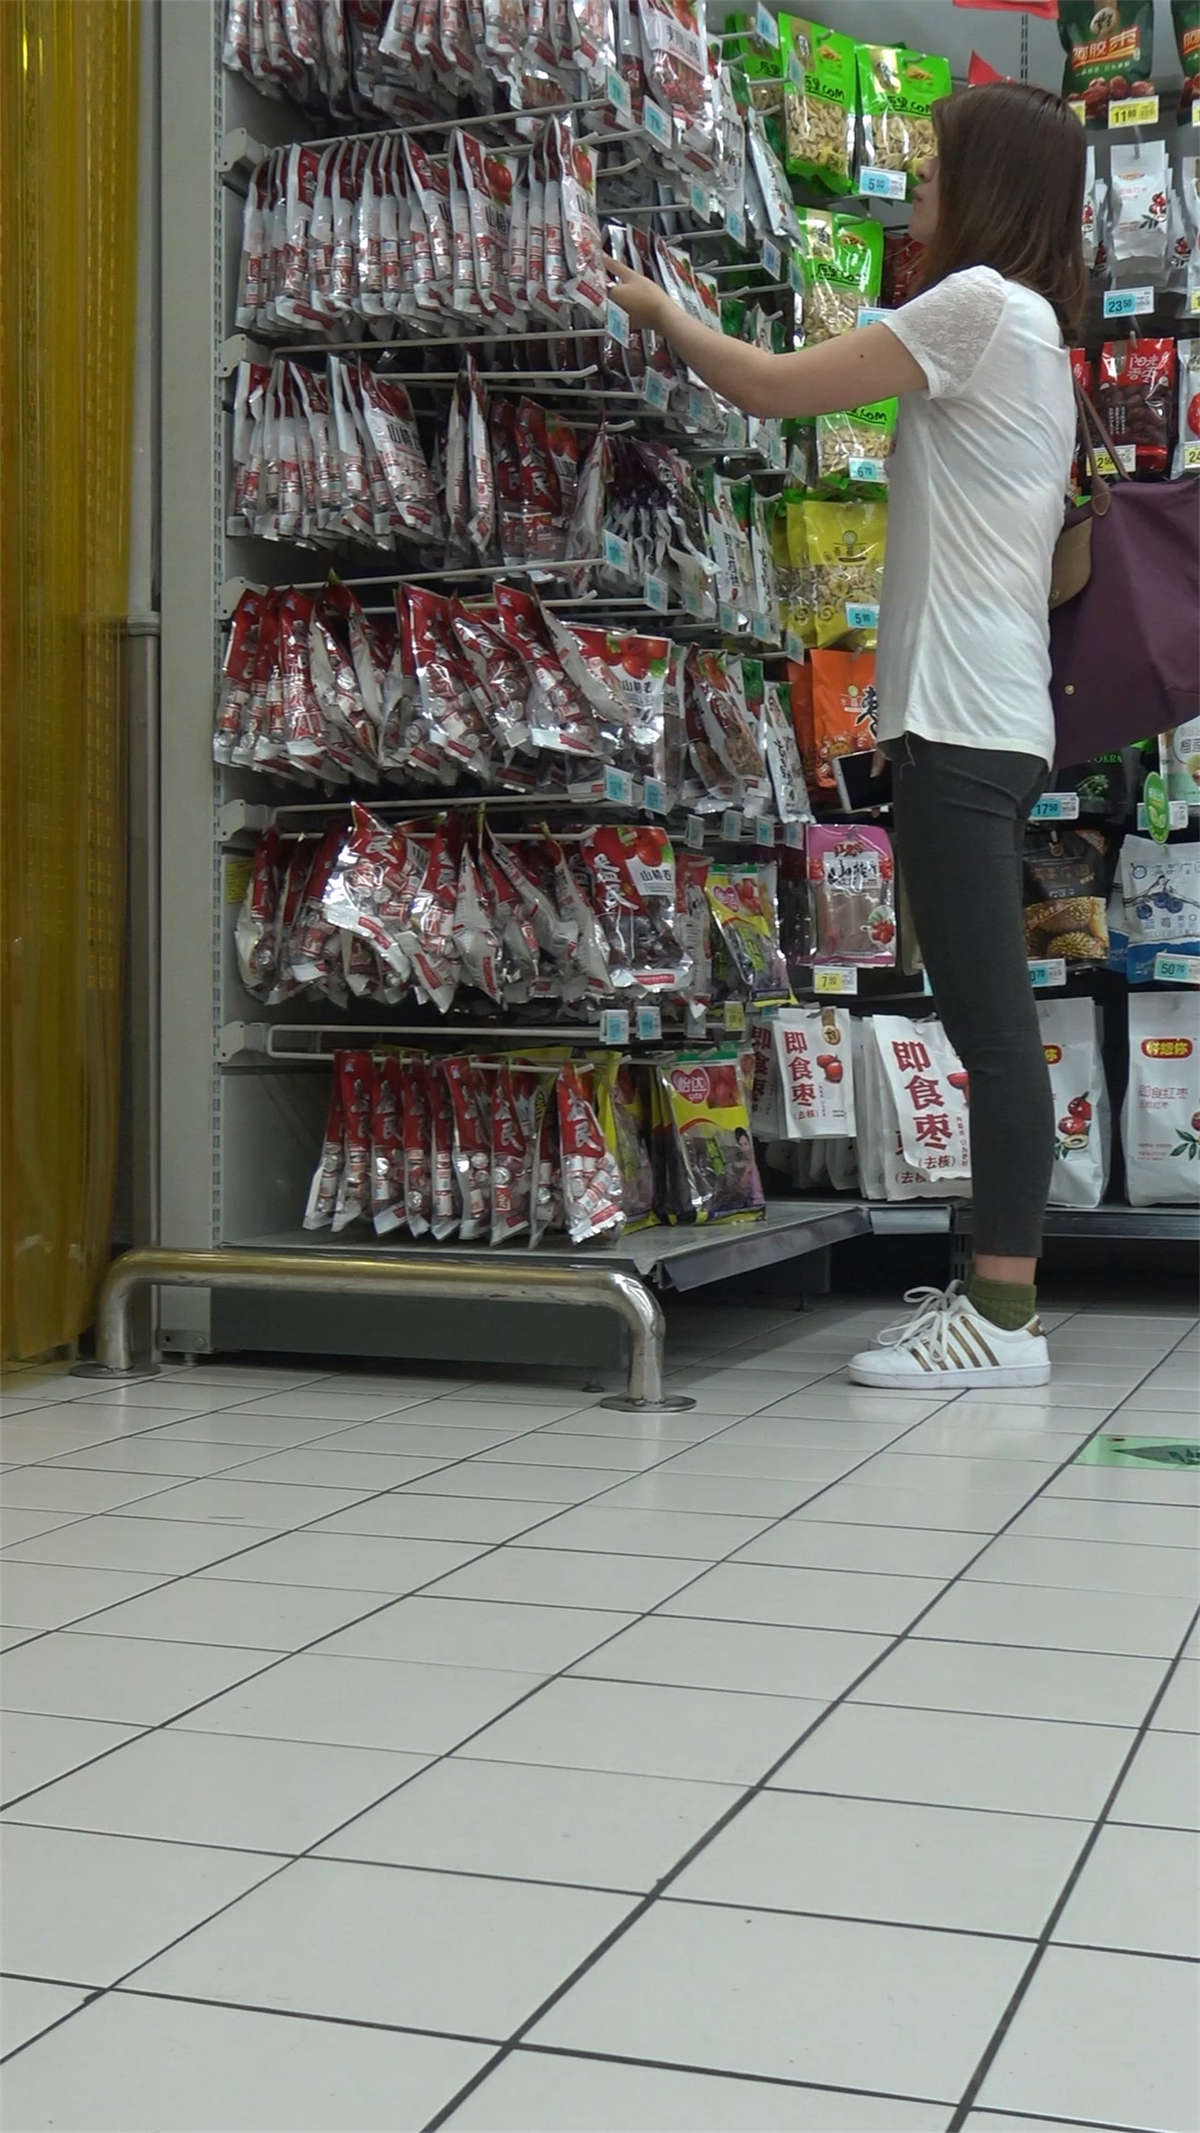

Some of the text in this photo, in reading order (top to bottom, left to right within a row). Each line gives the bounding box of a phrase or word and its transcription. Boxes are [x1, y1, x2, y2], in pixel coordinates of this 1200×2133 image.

[784, 1030, 817, 1107] 即食枣
[891, 1040, 953, 1151] 即食枣
